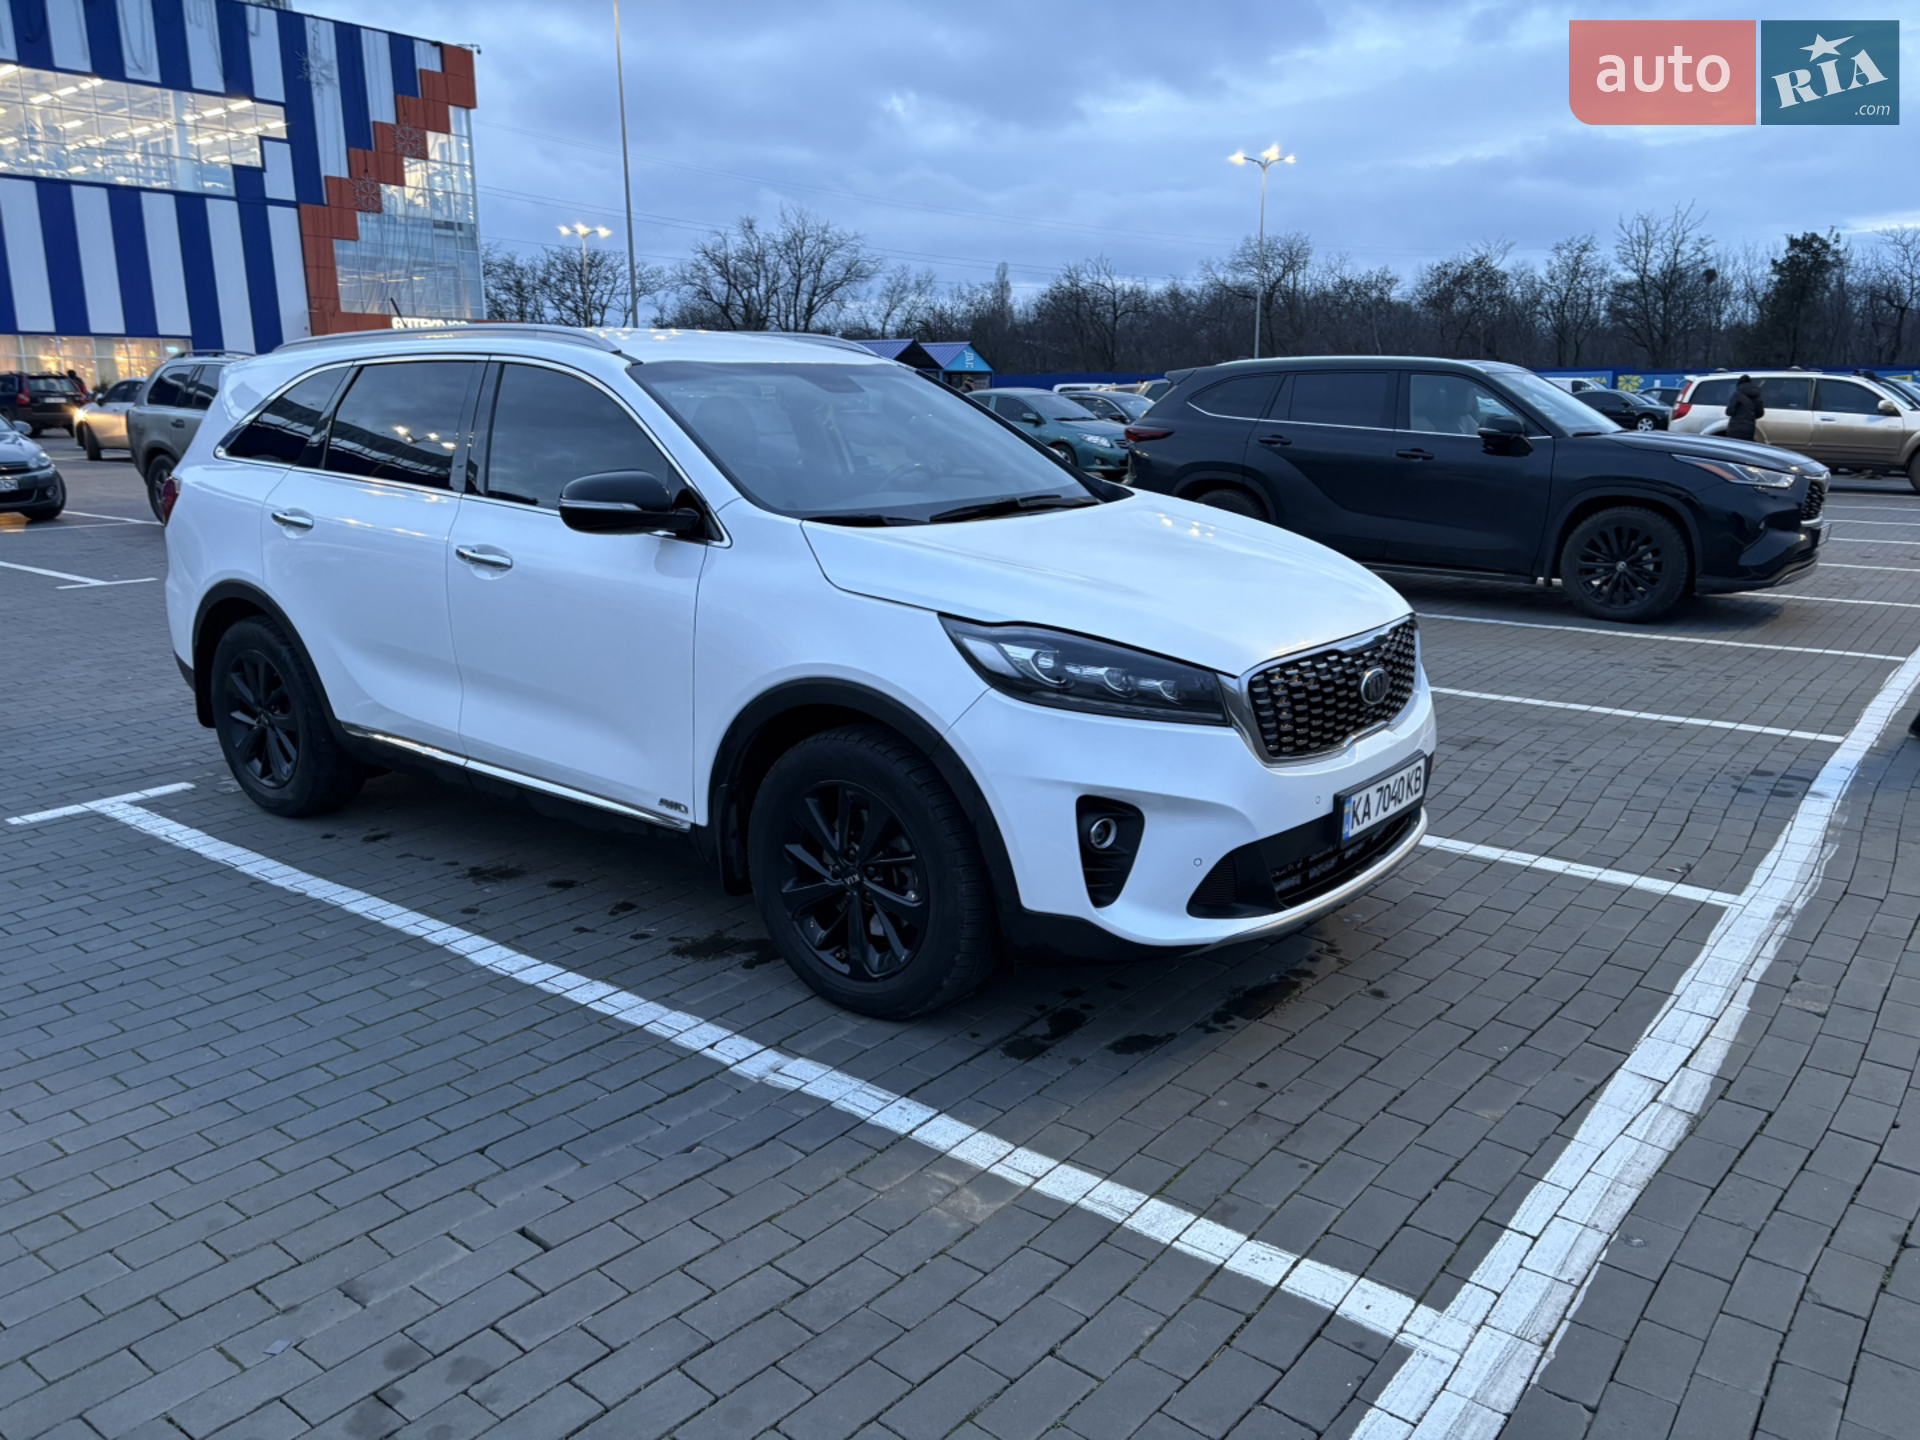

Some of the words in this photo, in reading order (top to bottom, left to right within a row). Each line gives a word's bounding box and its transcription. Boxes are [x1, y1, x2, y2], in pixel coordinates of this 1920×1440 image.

[1351, 793, 1371, 830] KA
[1375, 776, 1405, 817] 7040
[1406, 765, 1422, 800] KB
